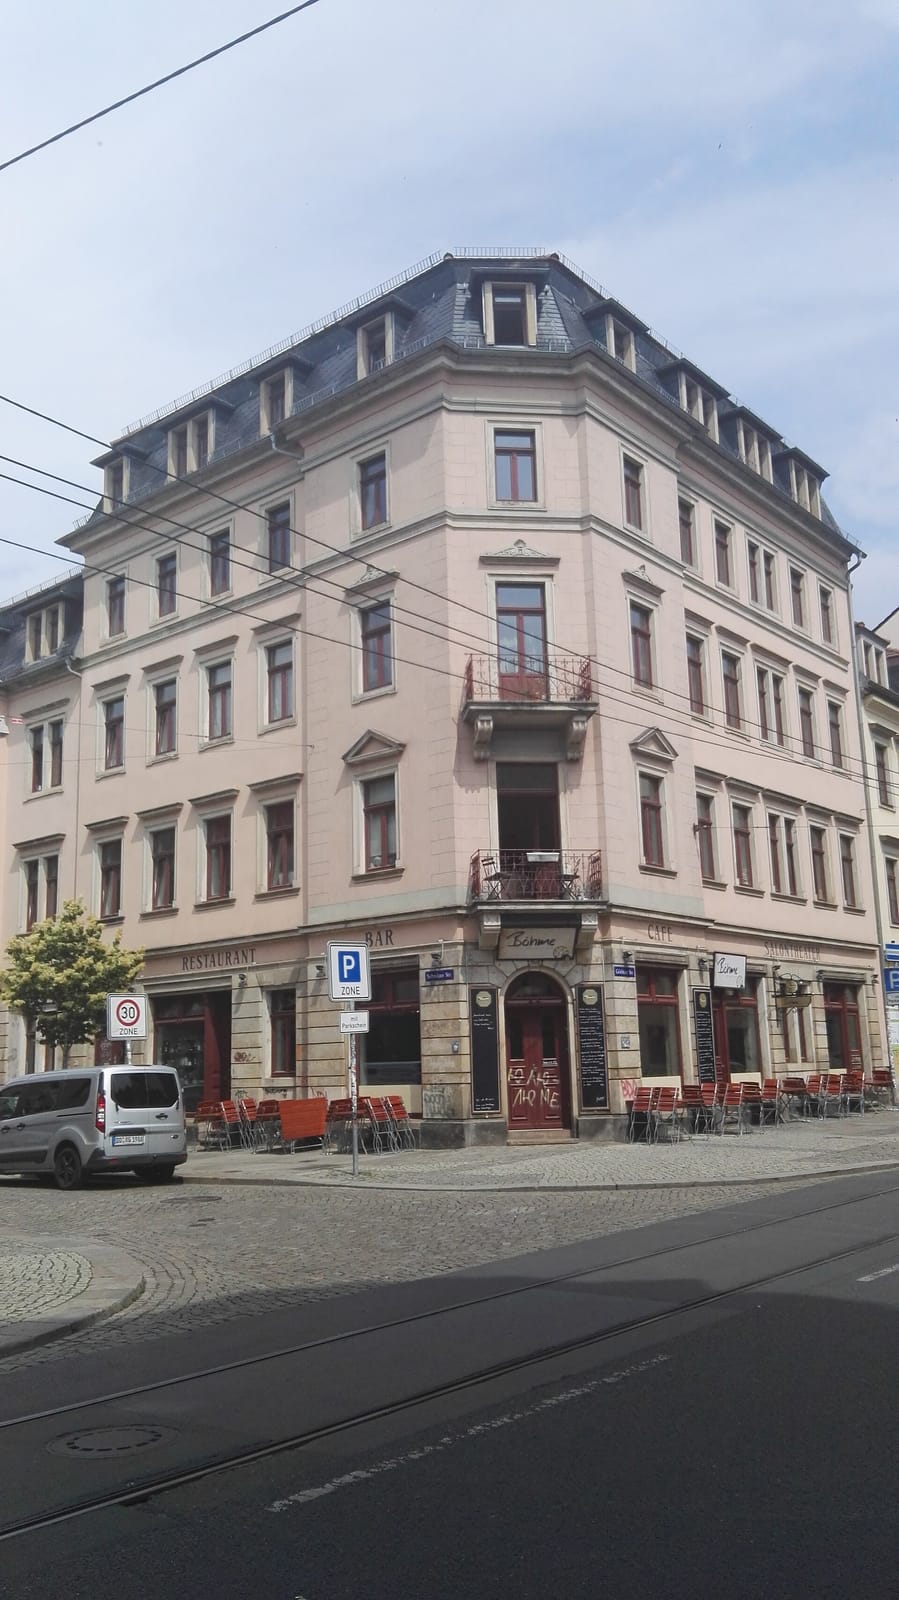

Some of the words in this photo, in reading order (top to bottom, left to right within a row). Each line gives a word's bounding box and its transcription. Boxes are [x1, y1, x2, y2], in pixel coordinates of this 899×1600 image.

[365, 929, 394, 947] BAR
[506, 930, 556, 947] Böhme
[182, 948, 256, 971] RESTAURANT
[343, 955, 355, 979] P
[341, 986, 361, 996] ZONE
[121, 1006, 136, 1019] 30
[119, 1027, 139, 1036] ZONE
